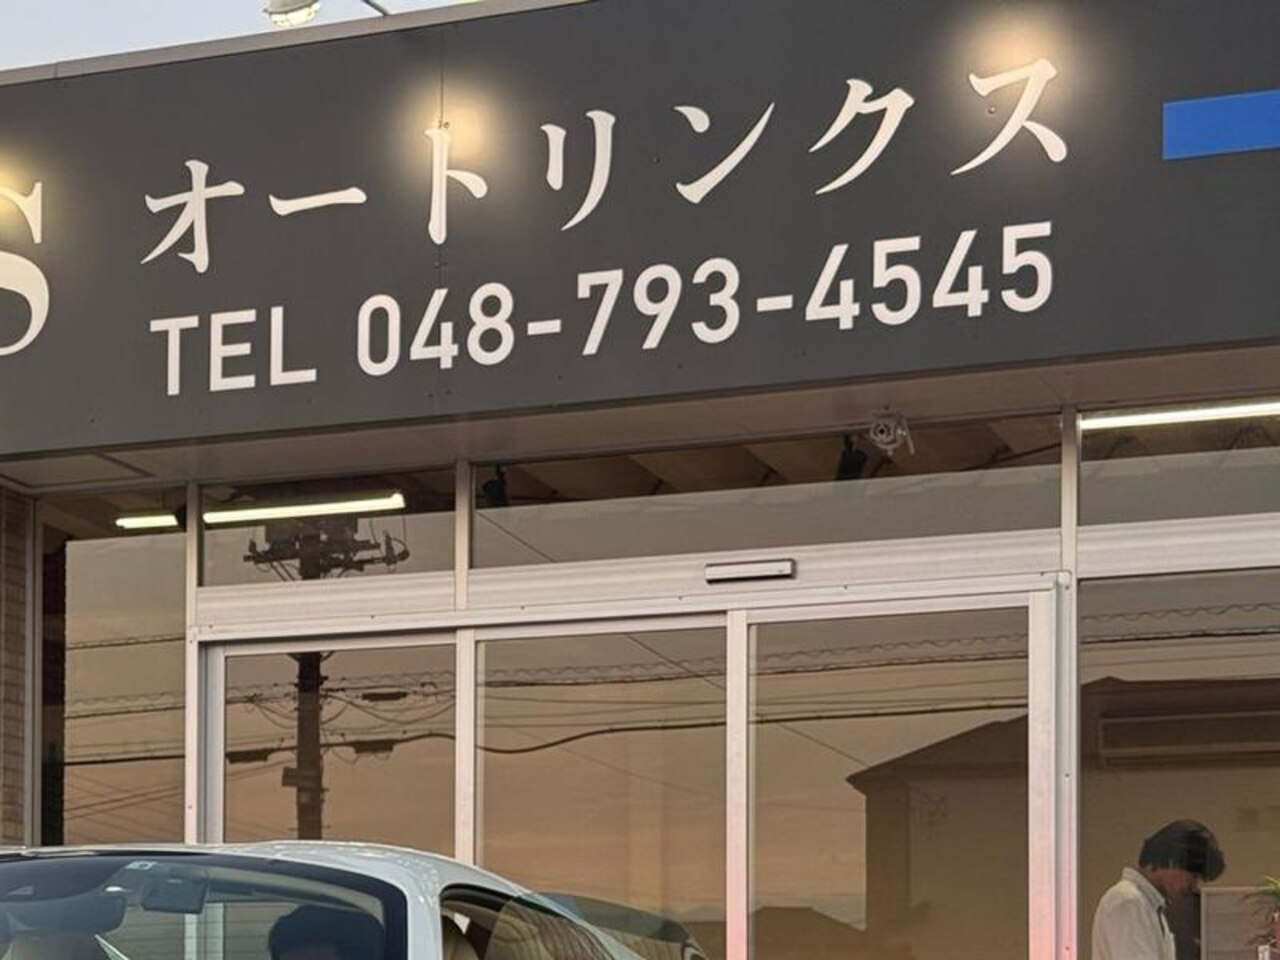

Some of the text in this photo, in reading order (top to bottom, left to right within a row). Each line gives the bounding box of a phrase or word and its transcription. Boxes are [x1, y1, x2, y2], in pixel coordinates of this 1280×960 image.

[141, 58, 1067, 273] オートリンクス
[150, 221, 1053, 396] TEL 048-793-4545
